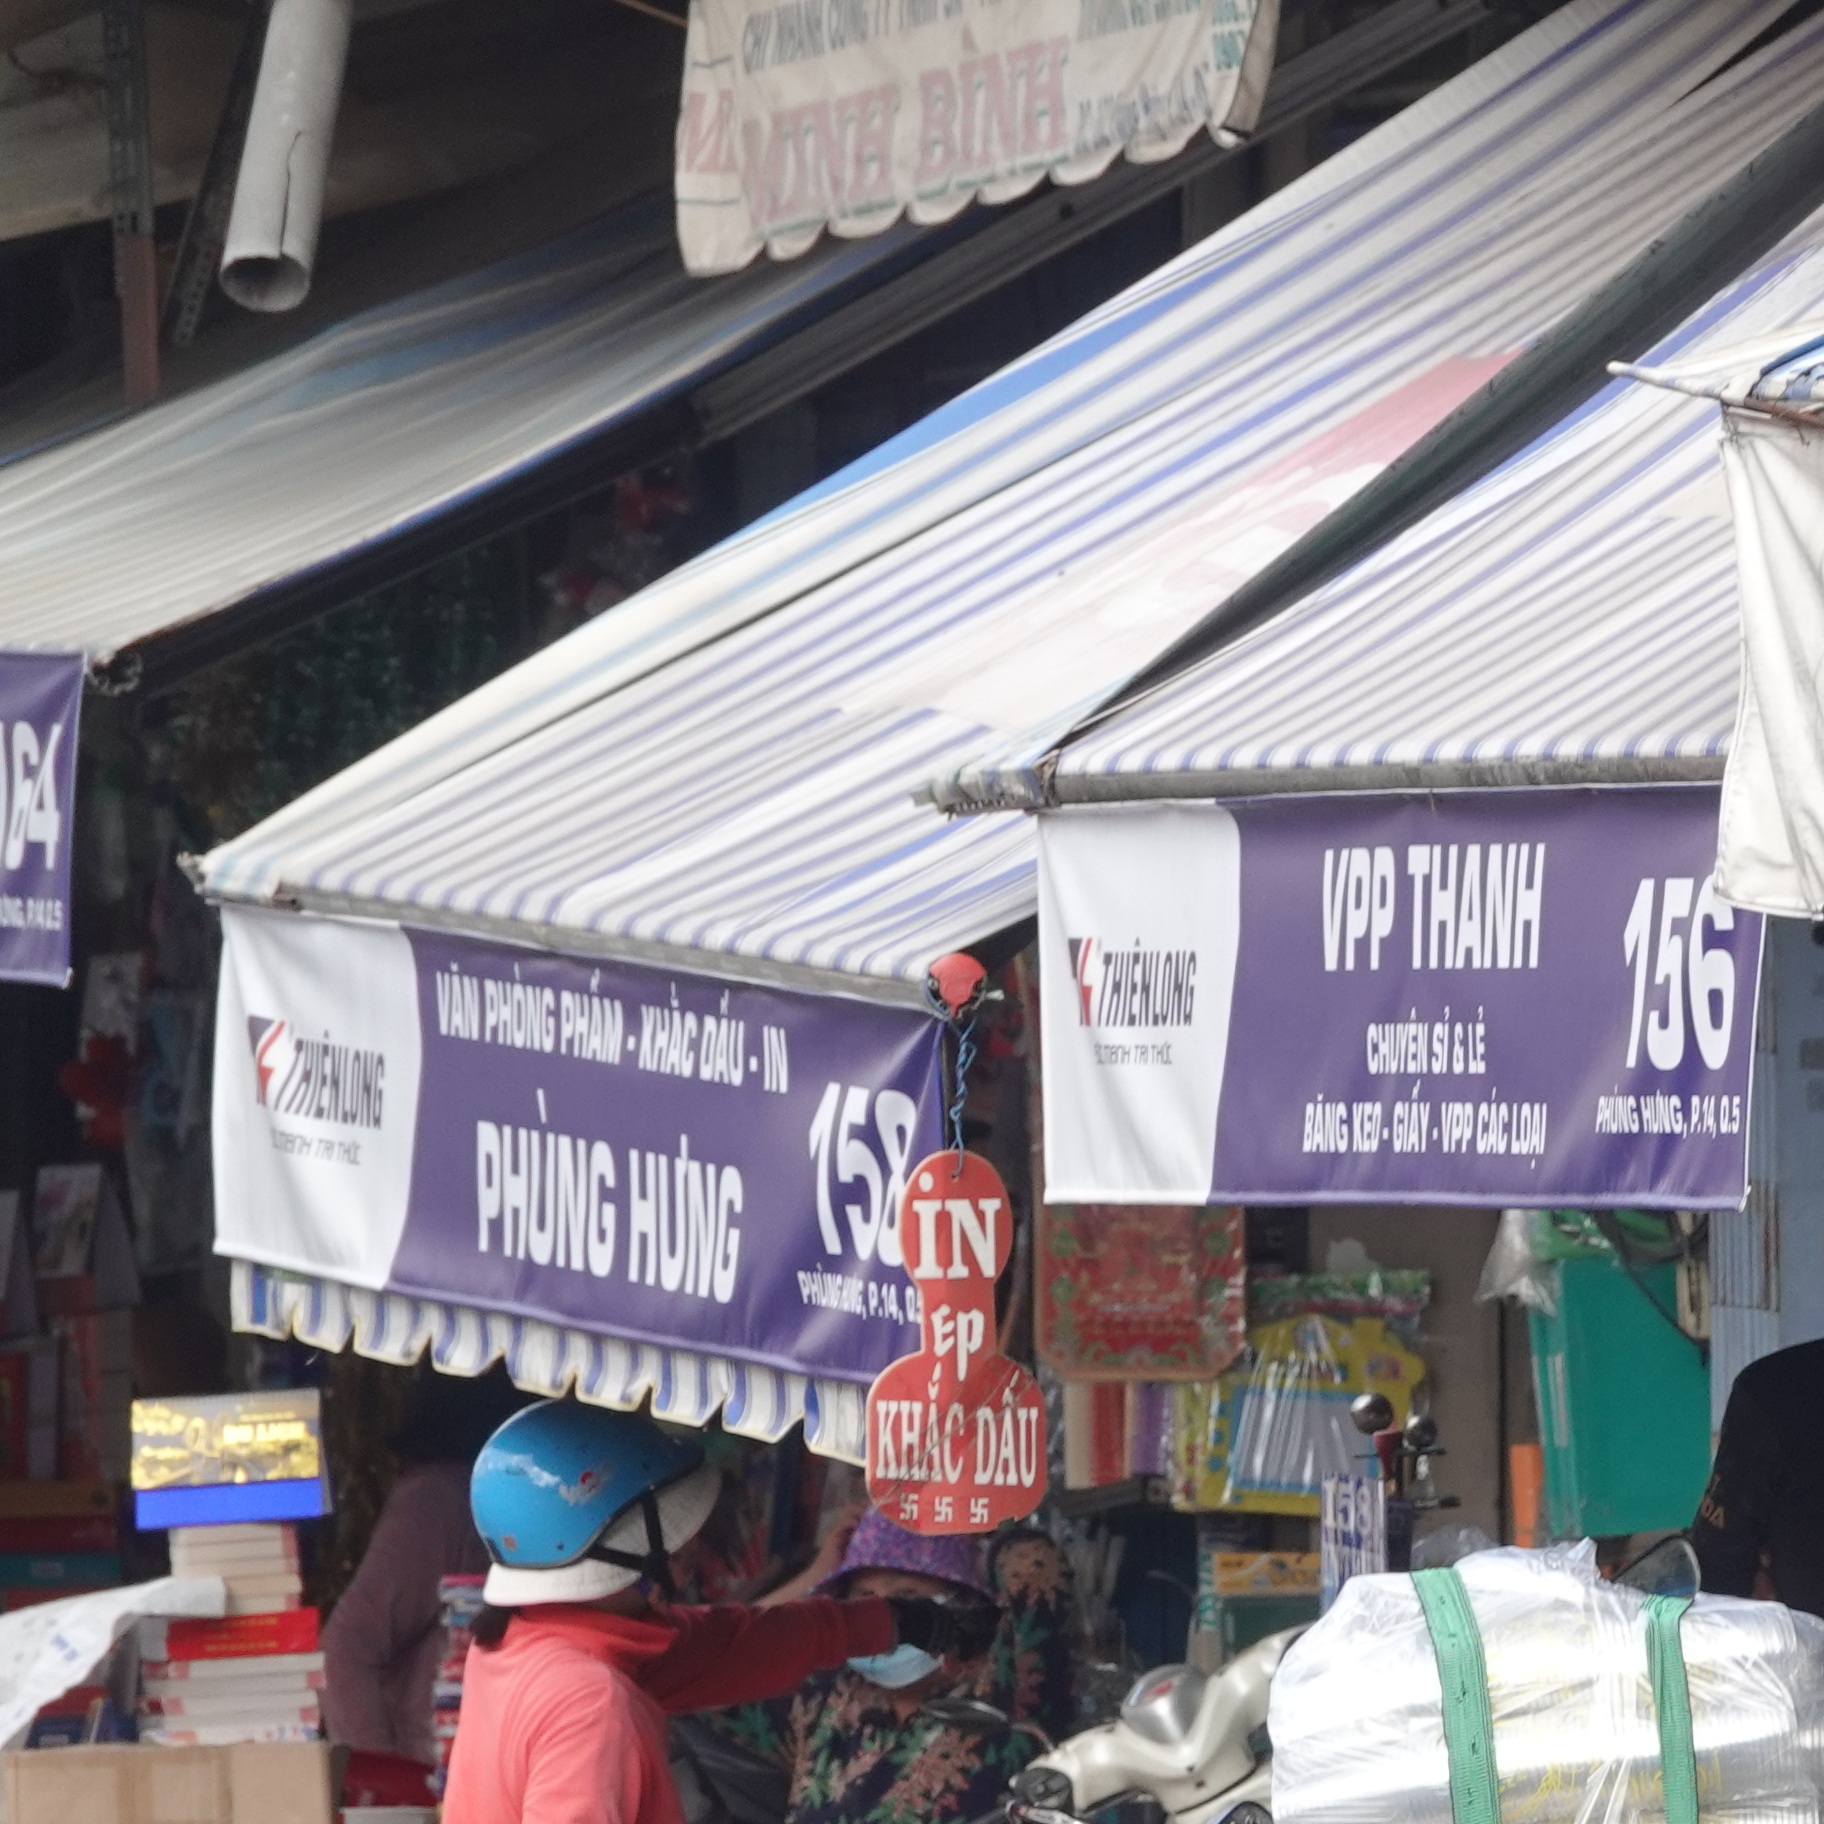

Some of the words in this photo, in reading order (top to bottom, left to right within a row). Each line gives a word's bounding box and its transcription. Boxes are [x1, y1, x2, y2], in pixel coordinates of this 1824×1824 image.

[744, 86, 897, 226] MINH
[914, 25, 1070, 190] BÌNH
[1323, 846, 1396, 972] VPP
[1407, 842, 1545, 970] THANH
[436, 962, 480, 1041] VĂN
[484, 962, 555, 1053] PHÒNG
[559, 968, 623, 1065] PHẨM
[627, 1034, 636, 1051] -
[639, 981, 698, 1078] KHẮC
[700, 988, 744, 1087] DẤU
[749, 1055, 758, 1072] -
[763, 1025, 788, 1094] IN
[1098, 936, 1197, 1028] THIÊNLONG
[1623, 872, 1736, 1072] 156
[274, 1028, 386, 1130] THIÊNLONG
[1366, 1010, 1429, 1075] CHUYÊN
[1431, 1005, 1451, 1074] SỈ
[1452, 1023, 1464, 1074] &
[1468, 1005, 1486, 1075] LẺ
[808, 1081, 917, 1268] 158
[1302, 1093, 1349, 1154] BĂNG
[1352, 1101, 1382, 1154] KEO
[1393, 1078, 1431, 1154] GIẤY
[1441, 1102, 1474, 1154] VPP
[1476, 1086, 1508, 1154] CÁC
[1511, 1102, 1547, 1170] LOẠI
[1596, 1084, 1639, 1134] PHÙNG
[1640, 1087, 1687, 1139] HƯNG,
[1690, 1095, 1717, 1139] P.14,
[1720, 1095, 1741, 1134] Q.5
[477, 1088, 614, 1278] PHÙNG
[628, 1134, 744, 1303] HƯNG
[797, 1262, 840, 1310] PHÙNG
[868, 1280, 904, 1326] P.14,
[875, 1361, 964, 1483] KHẮC
[974, 1370, 1040, 1488] DẤU
